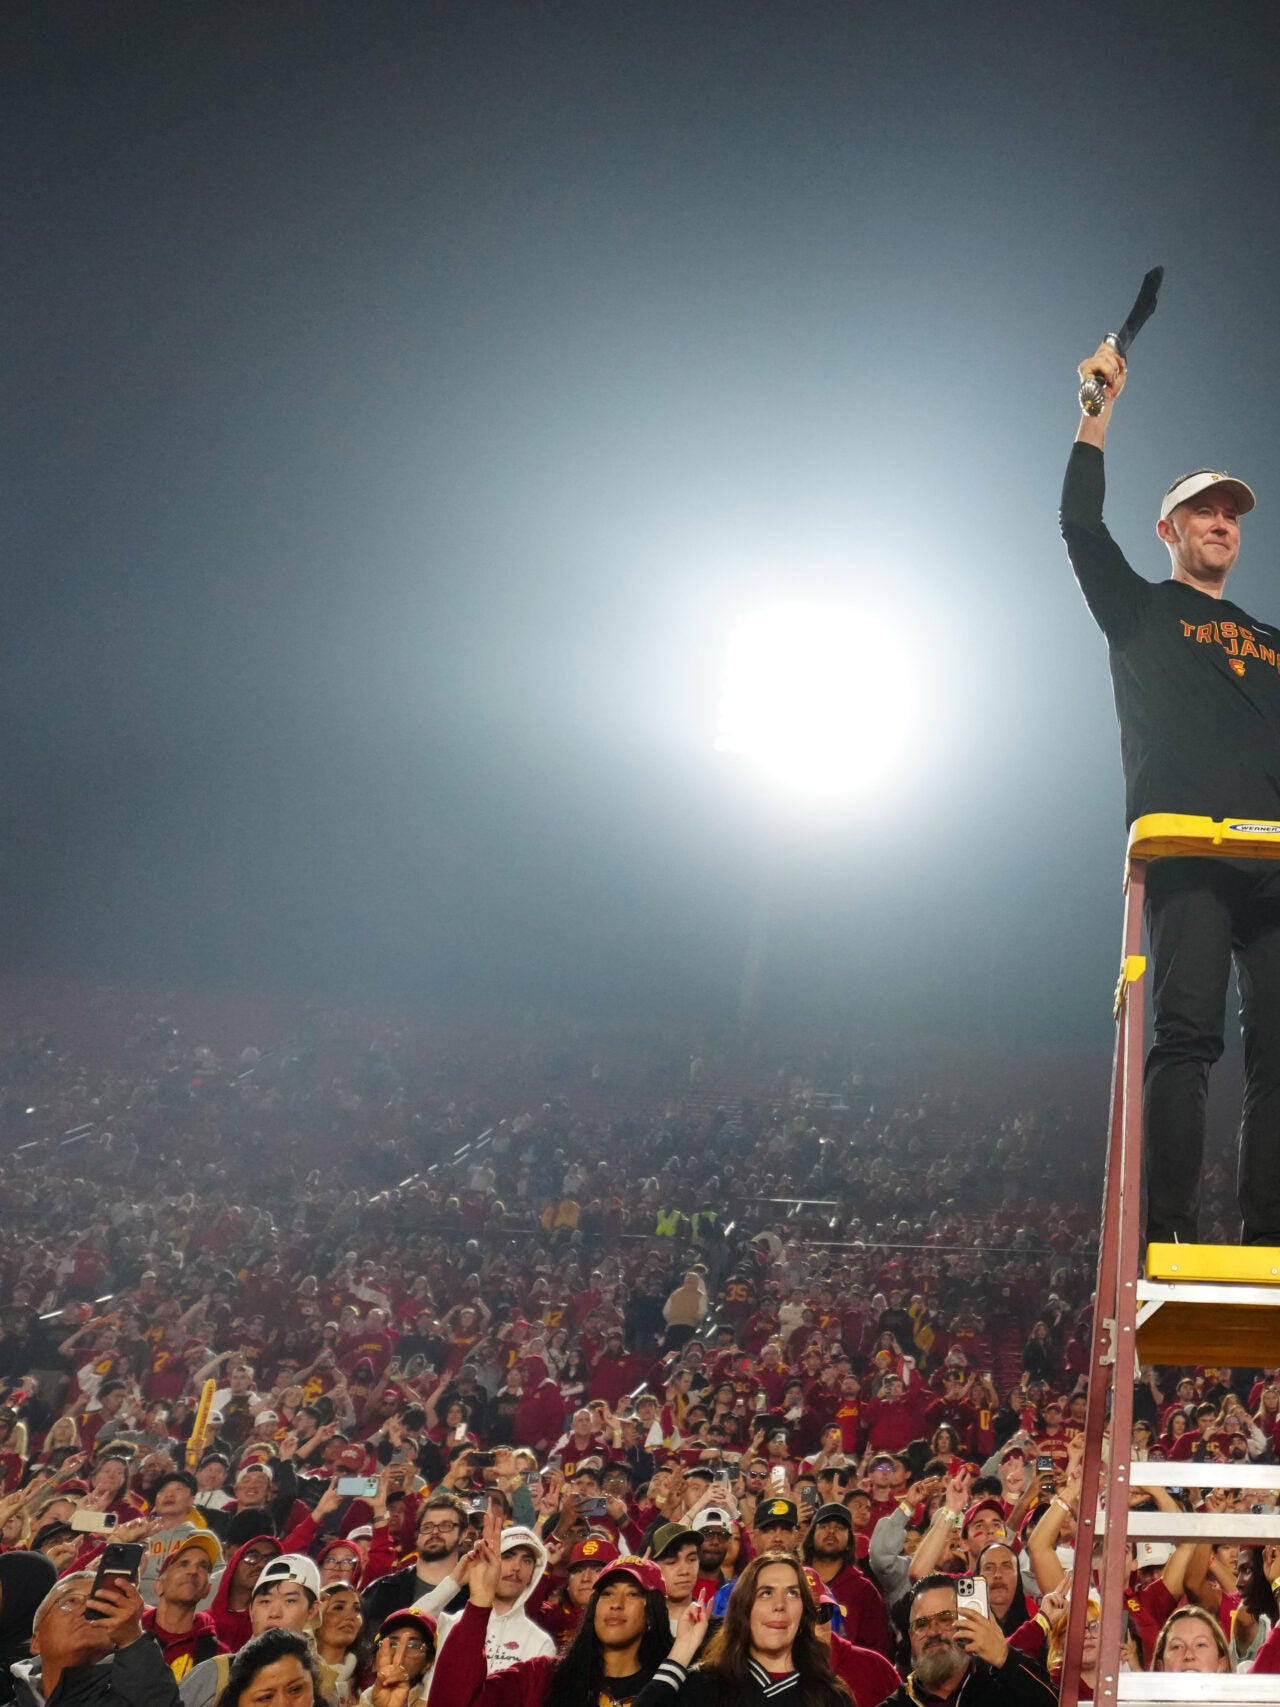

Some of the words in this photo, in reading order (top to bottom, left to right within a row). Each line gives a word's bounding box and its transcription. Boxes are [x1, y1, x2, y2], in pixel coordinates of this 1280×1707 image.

[1215, 621, 1256, 641] SC
[1240, 824, 1278, 833] WERNER
[1127, 1599, 1140, 1612] SC
